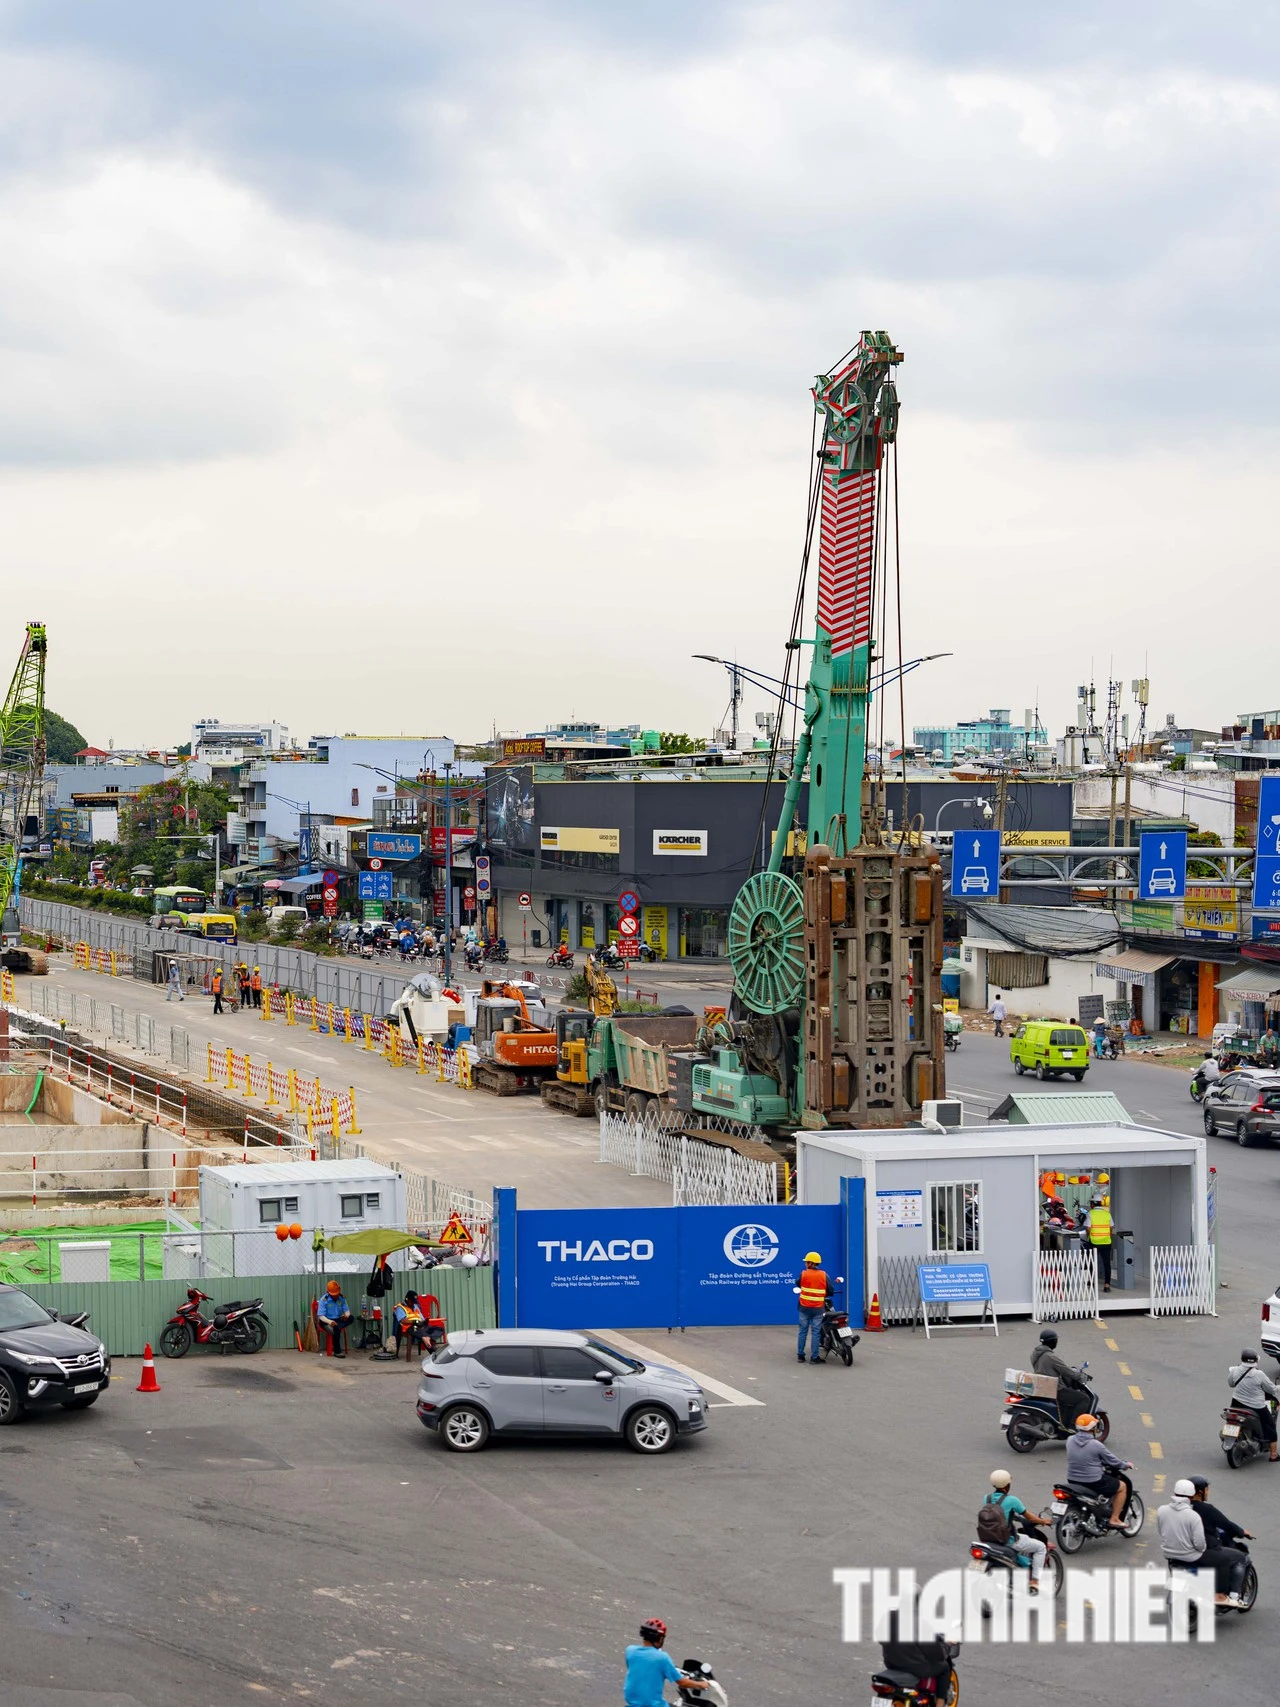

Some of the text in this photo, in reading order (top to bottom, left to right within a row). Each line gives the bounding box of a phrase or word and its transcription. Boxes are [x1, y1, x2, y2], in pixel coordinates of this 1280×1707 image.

[1040, 838, 1067, 846] SERVICE
[372, 860, 380, 868] 50
[523, 1045, 559, 1055] HITAC
[537, 1239, 654, 1262] THACO
